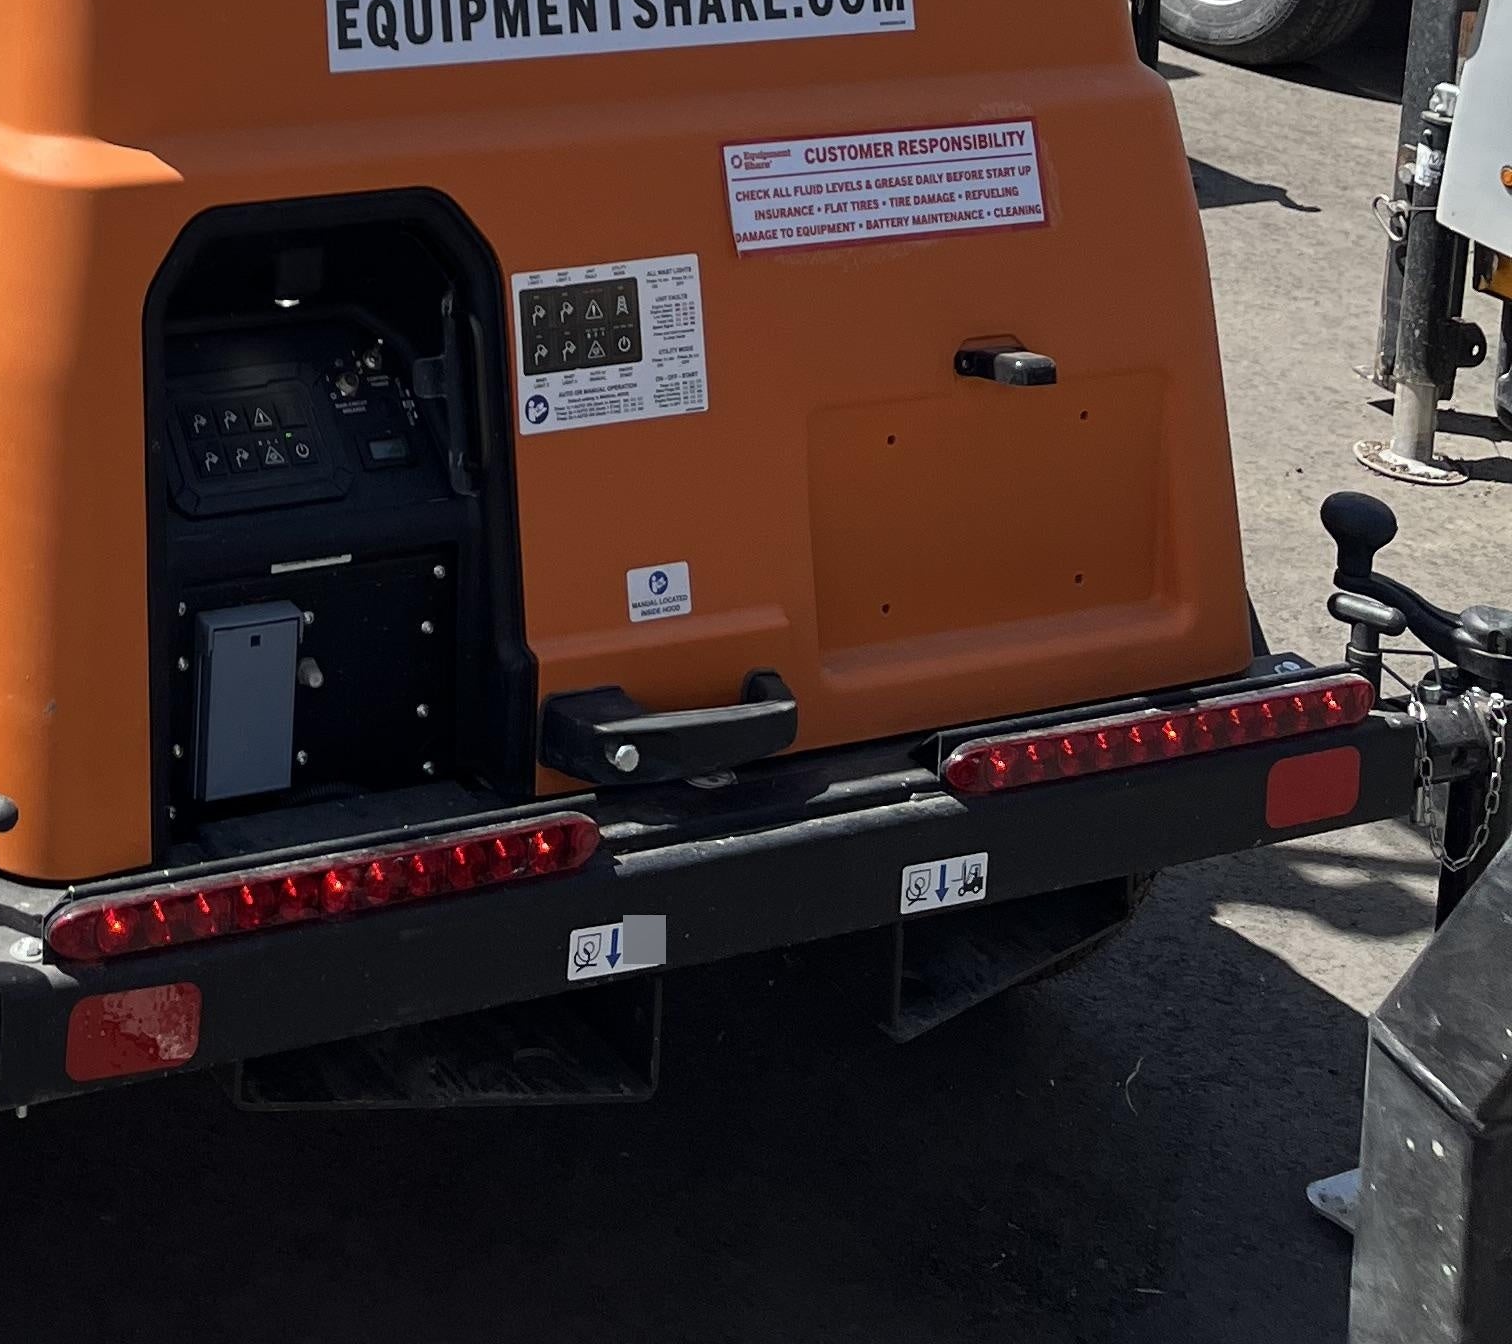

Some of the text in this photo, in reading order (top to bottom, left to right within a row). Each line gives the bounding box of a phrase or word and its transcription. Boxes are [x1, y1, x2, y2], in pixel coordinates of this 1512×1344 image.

[743, 149, 791, 161] Equipment
[804, 130, 1026, 164] CUSTOMER RESPONSIBILITY
[744, 161, 771, 170] Share
[735, 165, 1032, 202] CHECK ALL FLUID LEVELS & GREASE DAILY BEFORE START UP
[754, 186, 1020, 221] INSURANCE FLAT TIRES TIRE DAMAGE REFUELING
[736, 204, 1042, 243] DAMAGE TO EQUIPMENT BATTERY MAINTENANCE CLEANING
